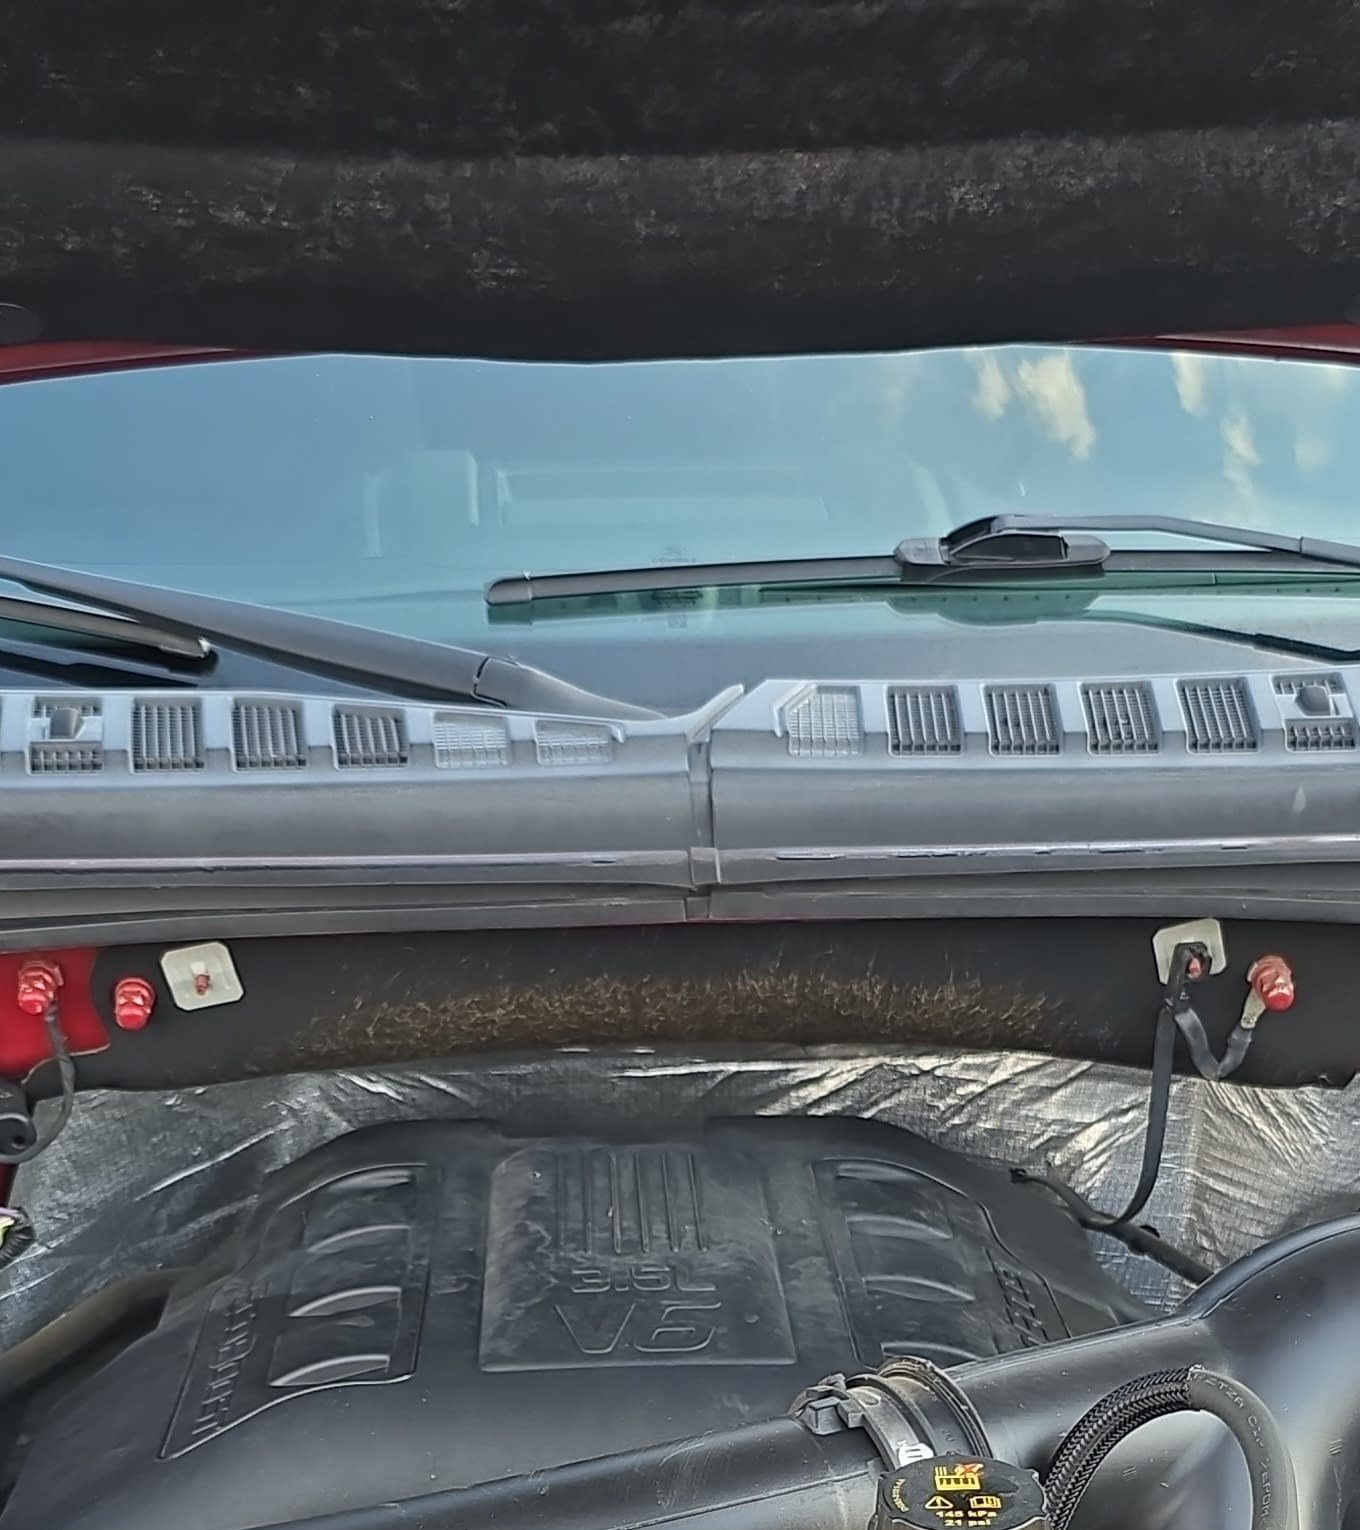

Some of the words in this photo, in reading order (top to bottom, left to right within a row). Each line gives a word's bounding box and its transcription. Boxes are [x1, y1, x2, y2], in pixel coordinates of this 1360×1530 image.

[570, 1266, 715, 1293] 3.5L
[553, 1300, 722, 1354] V6
[936, 1510, 964, 1518] 145
[968, 1510, 997, 1518] kPa
[944, 1519, 963, 1527] 21
[968, 1519, 991, 1527] psi
